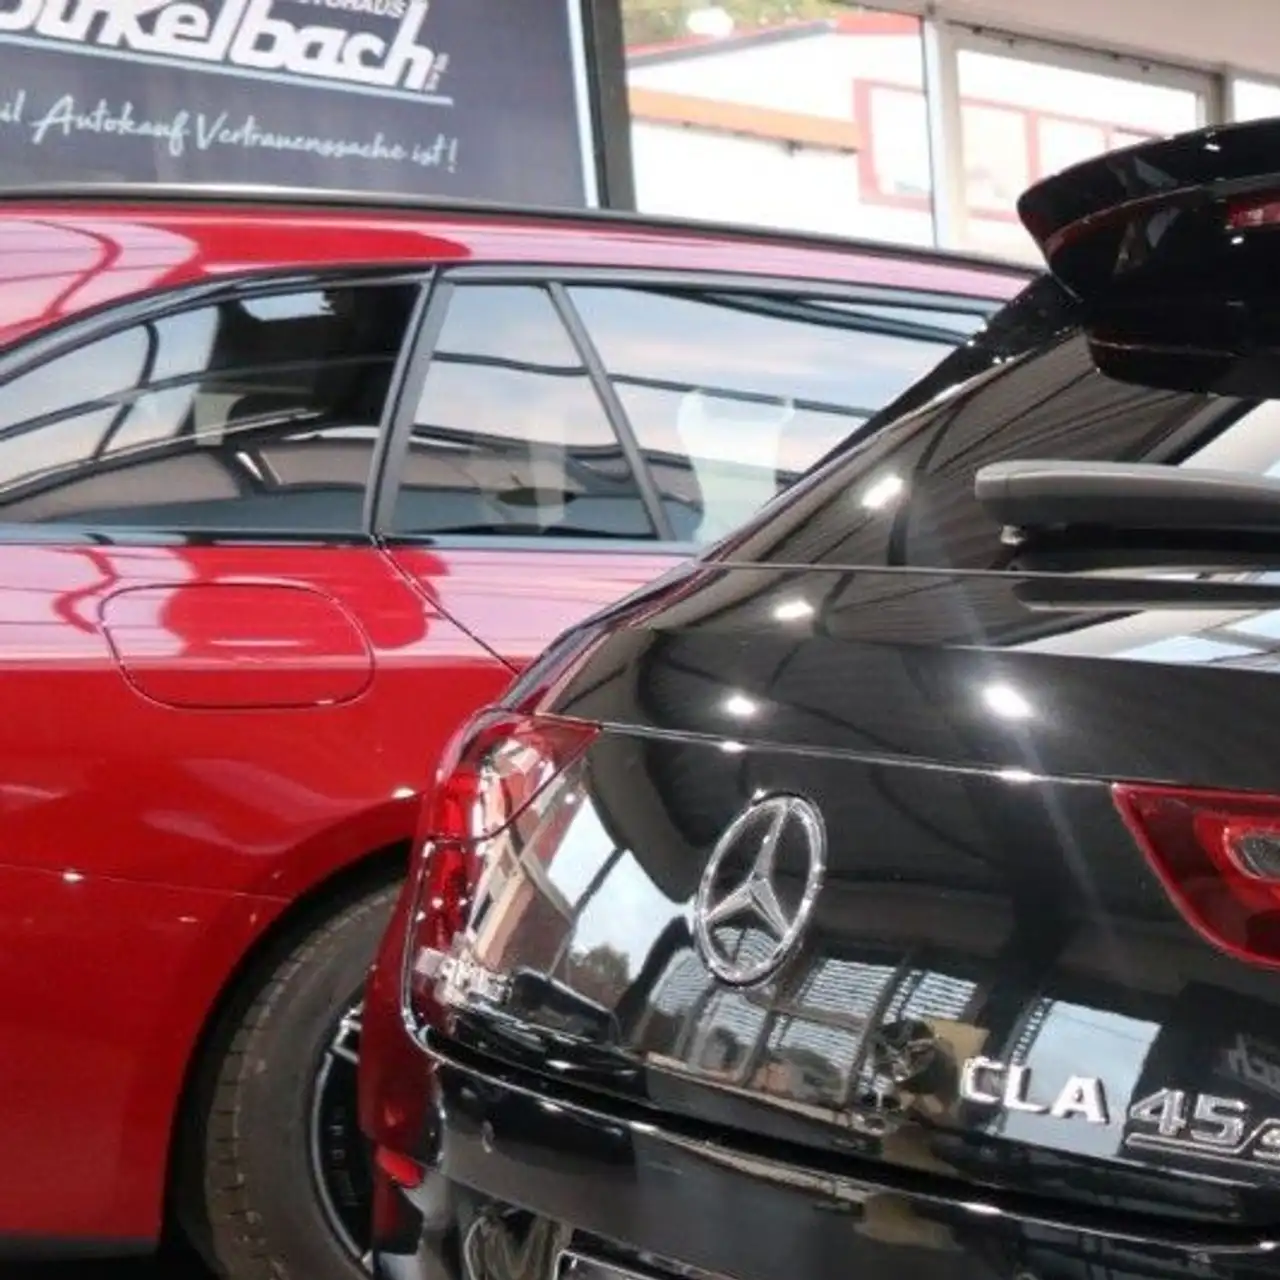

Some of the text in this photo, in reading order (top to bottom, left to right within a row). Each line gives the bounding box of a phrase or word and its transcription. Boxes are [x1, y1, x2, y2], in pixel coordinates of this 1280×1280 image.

[31, 93, 190, 157] Autokauf
[197, 111, 405, 160] Vertrauenssache
[960, 1056, 1110, 1125] CLA
